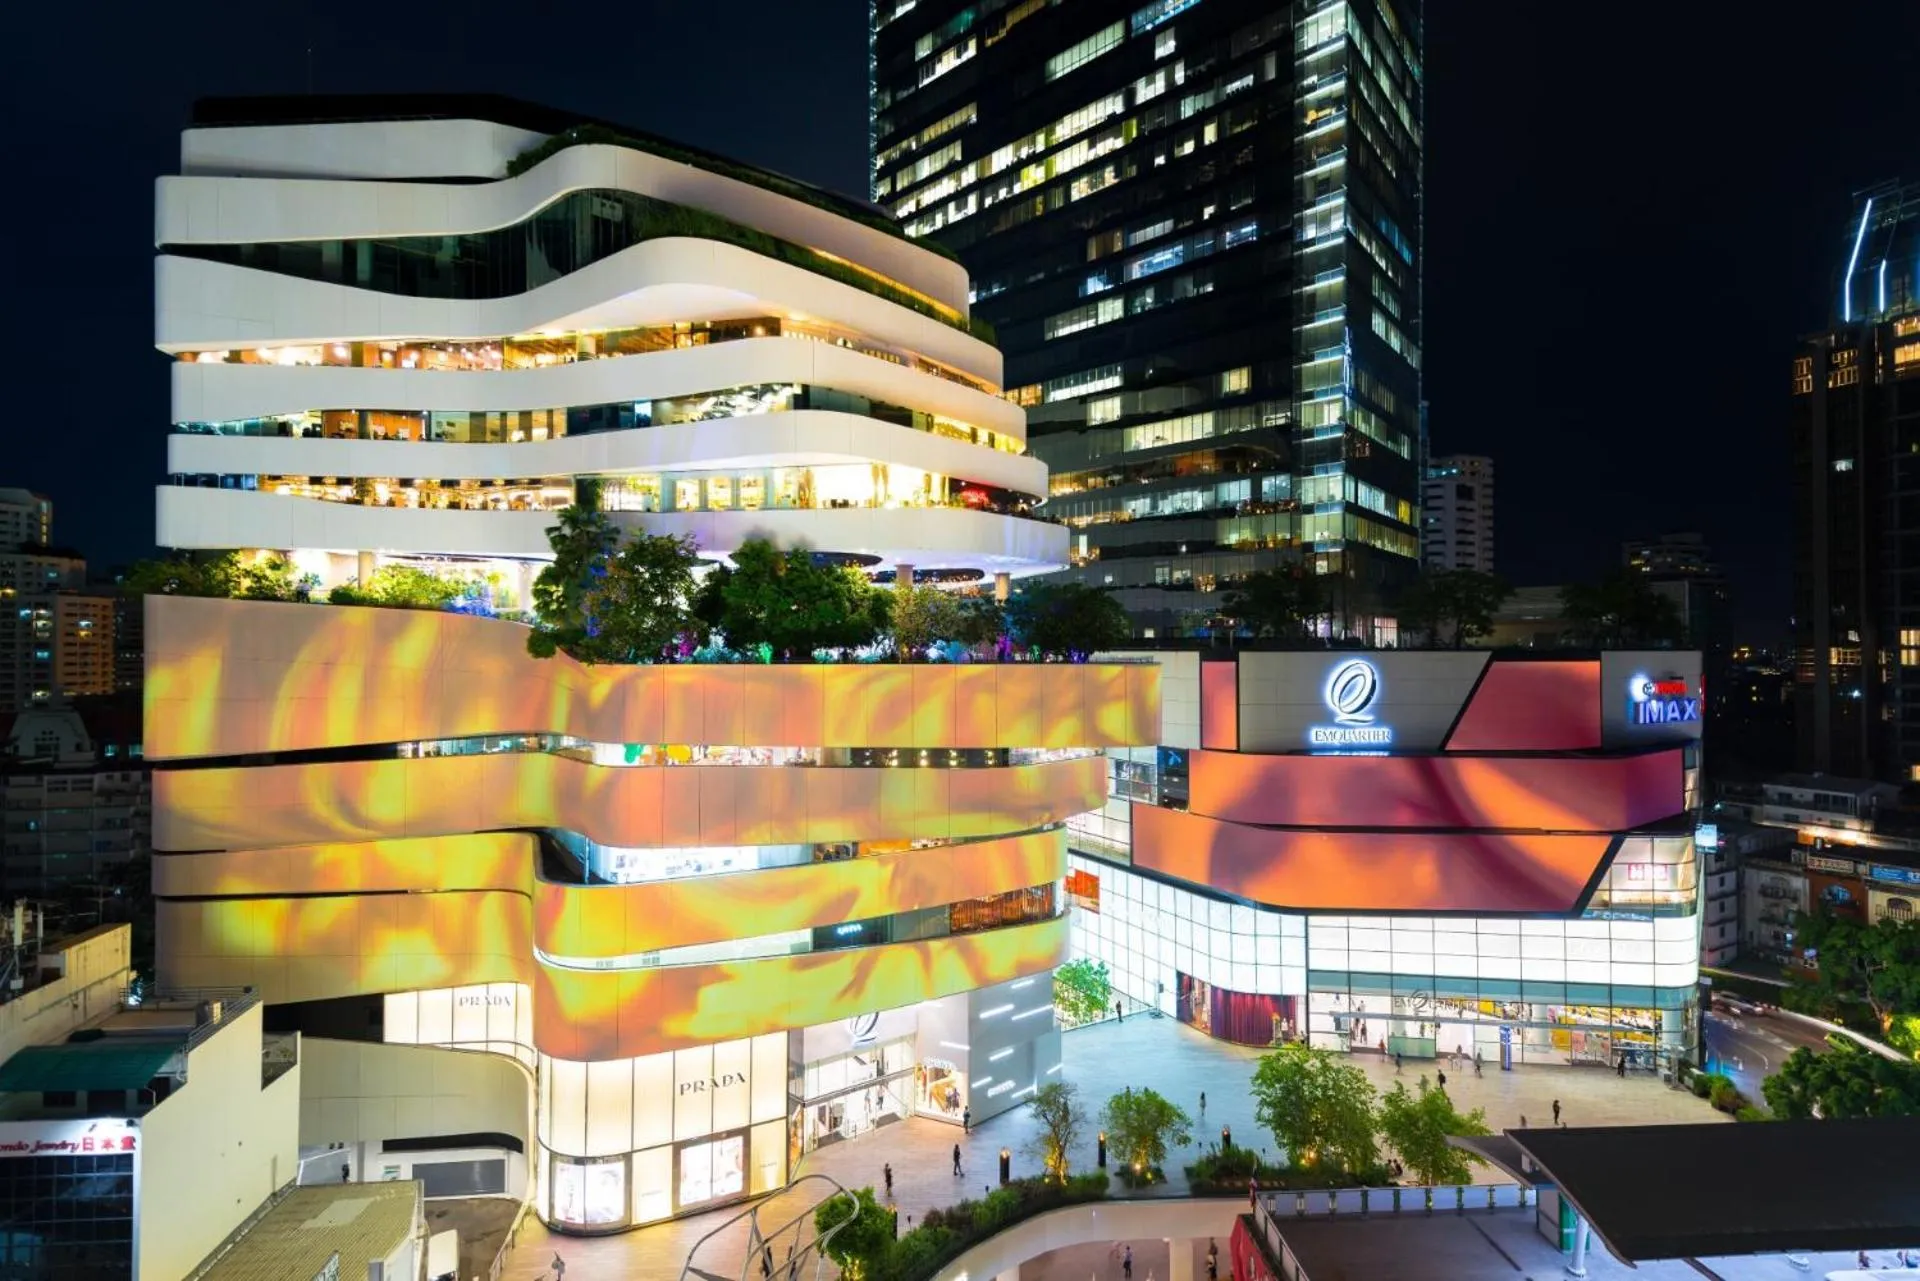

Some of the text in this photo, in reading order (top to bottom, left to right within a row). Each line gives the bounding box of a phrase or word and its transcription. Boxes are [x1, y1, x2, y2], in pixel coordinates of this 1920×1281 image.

[1639, 700, 1697, 723] IMAX
[1314, 730, 1392, 743] EMQUARTIER
[459, 995, 511, 1006] PRADA
[680, 1072, 745, 1096] PRADA
